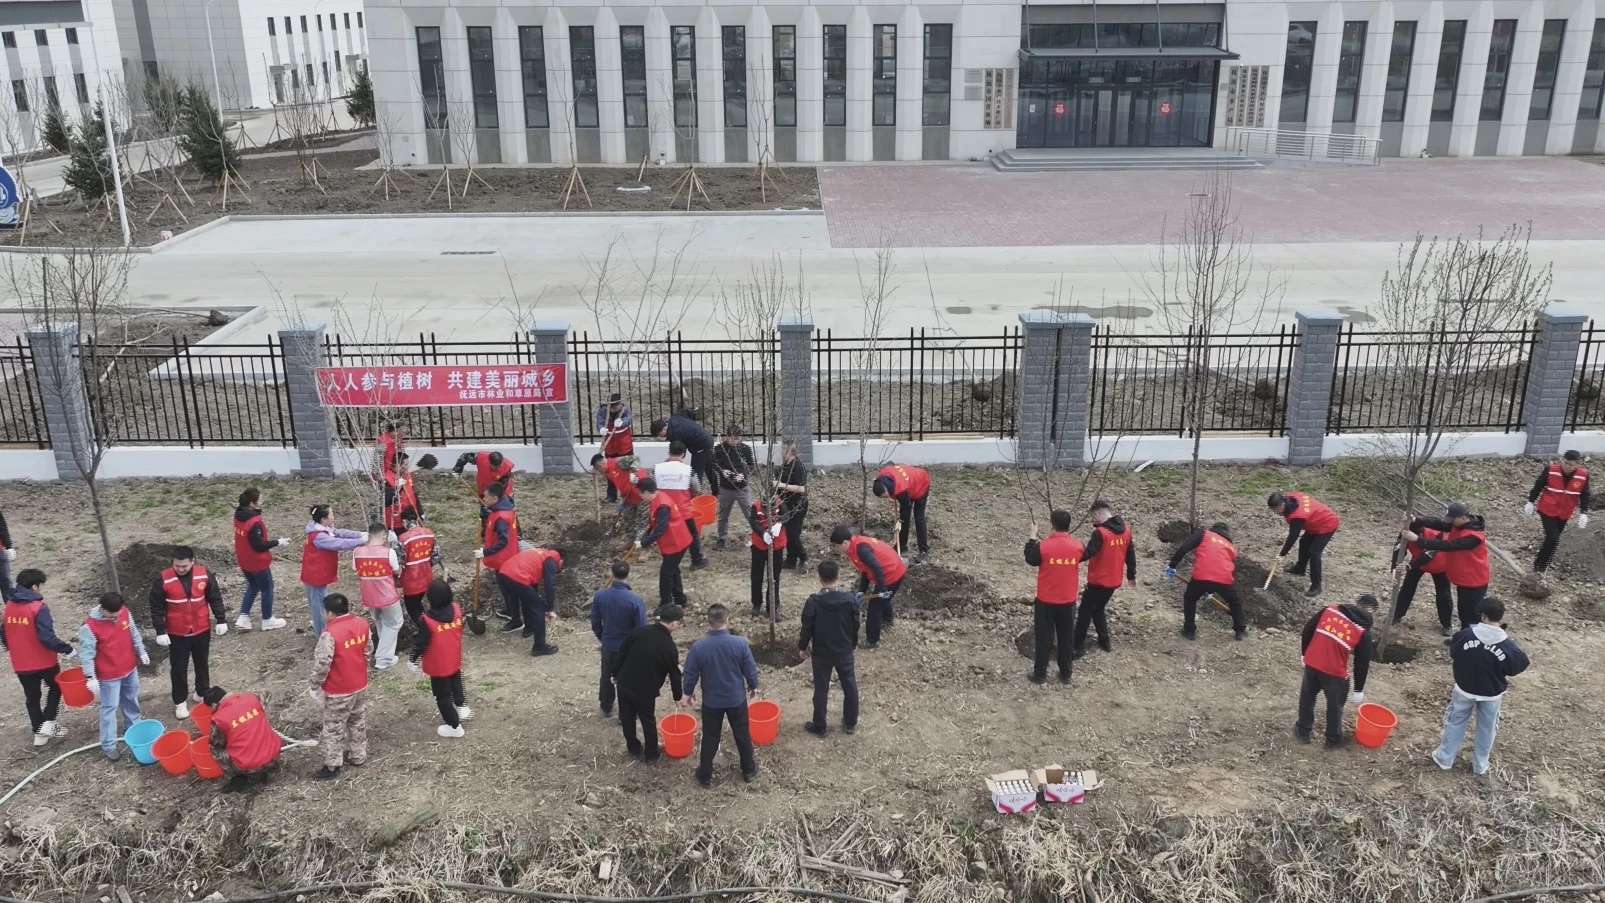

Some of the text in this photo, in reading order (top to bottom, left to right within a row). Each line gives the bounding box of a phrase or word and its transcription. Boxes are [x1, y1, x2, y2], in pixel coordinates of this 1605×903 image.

[326, 369, 556, 392] 人人参与植树 共建美丽城乡
[459, 387, 541, 400] 抚远市林业和草原局
[1483, 643, 1507, 662] CLUB
